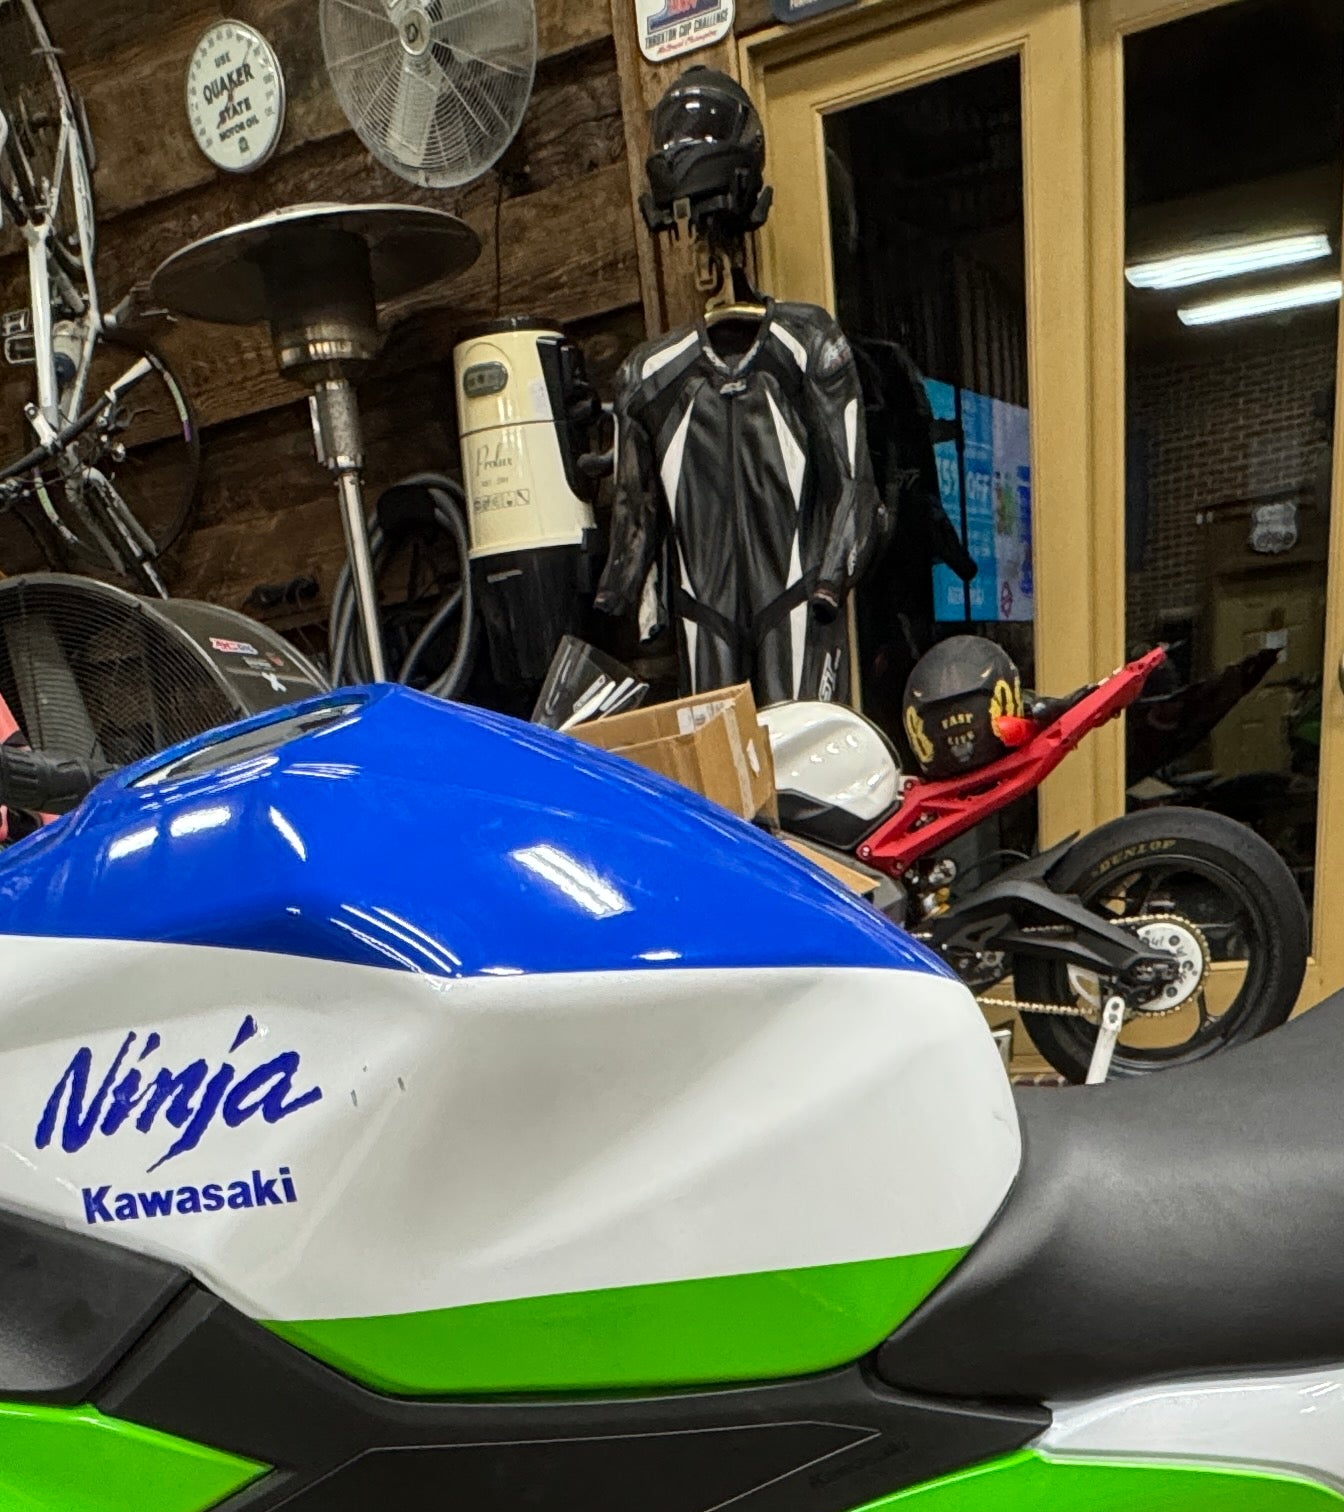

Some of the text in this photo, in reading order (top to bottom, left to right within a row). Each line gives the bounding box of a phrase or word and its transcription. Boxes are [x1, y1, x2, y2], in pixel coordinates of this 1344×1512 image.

[214, 51, 232, 69] USE
[202, 63, 255, 106] QUAKER
[218, 96, 252, 126] STATE
[219, 114, 260, 142] MOTOR OIL
[1098, 839, 1177, 874] DUNLOP
[35, 1014, 323, 1174] Ninja
[81, 1166, 298, 1225] Kawasaki
